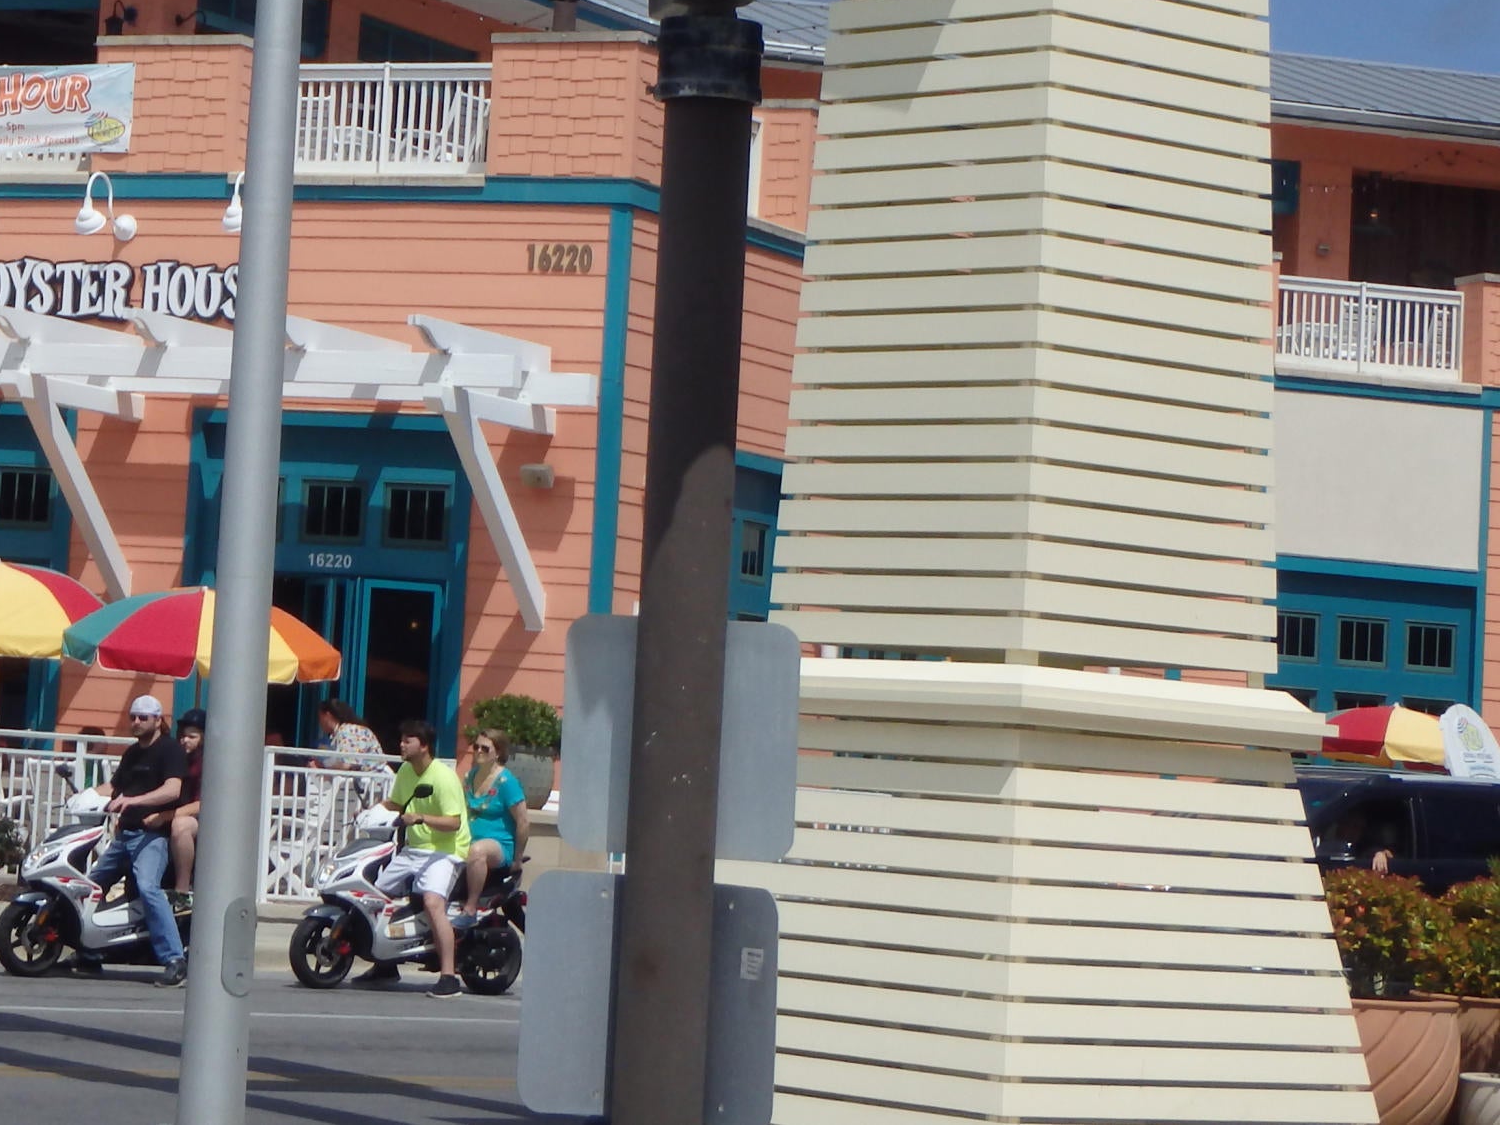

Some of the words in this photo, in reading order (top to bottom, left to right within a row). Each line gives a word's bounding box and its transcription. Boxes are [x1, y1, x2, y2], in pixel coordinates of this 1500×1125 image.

[6, 121, 26, 133] 5pm
[526, 243, 593, 273] 16220
[140, 259, 239, 320] HOUS
[308, 552, 352, 569] 16220
